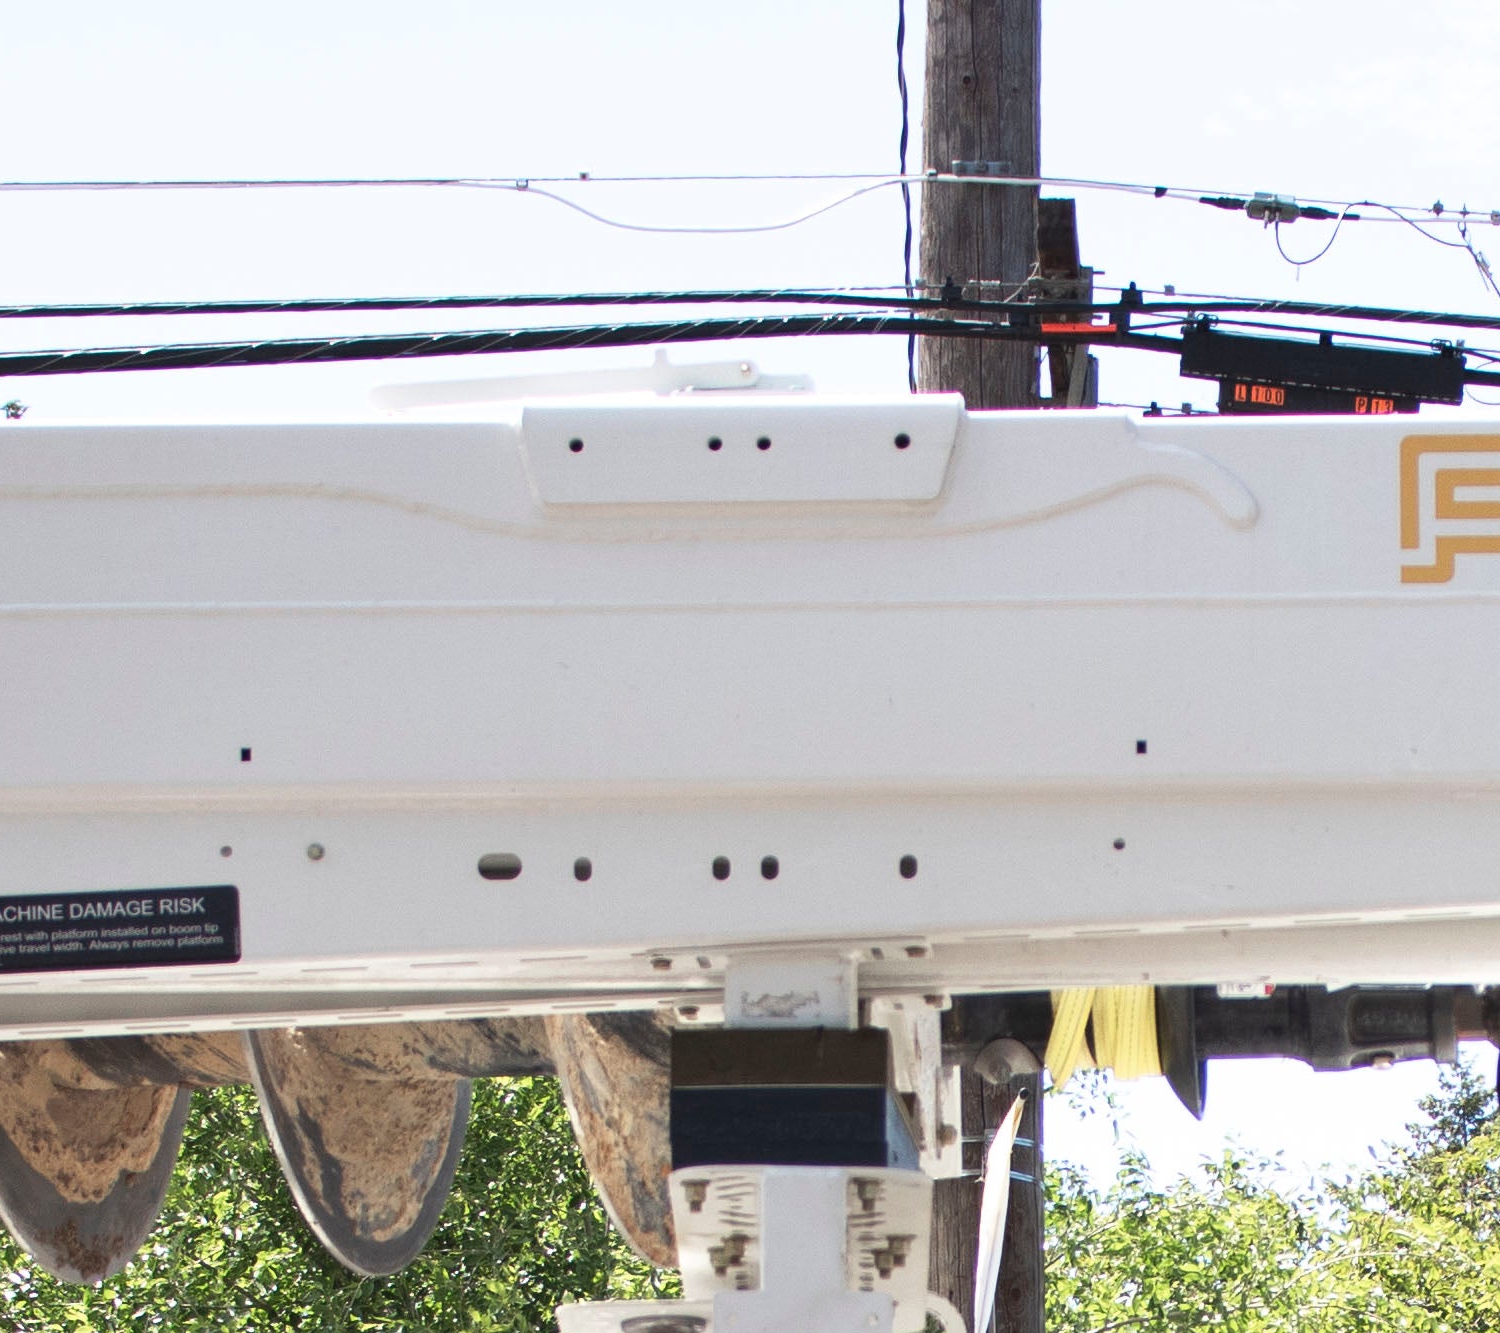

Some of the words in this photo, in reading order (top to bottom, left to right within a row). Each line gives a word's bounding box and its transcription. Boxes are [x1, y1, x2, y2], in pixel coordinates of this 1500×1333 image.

[69, 900, 154, 919] DAMAGE
[159, 897, 206, 914] RISK
[0, 932, 22, 943] rest
[25, 931, 49, 941] with
[51, 929, 98, 943] platform
[101, 926, 149, 937] installed
[151, 926, 166, 935] on
[168, 923, 201, 934] boom
[204, 922, 219, 934] tip
[18, 942, 50, 953] travel
[89, 939, 130, 951] Always
[132, 937, 175, 948] remove
[177, 934, 224, 947] platform
